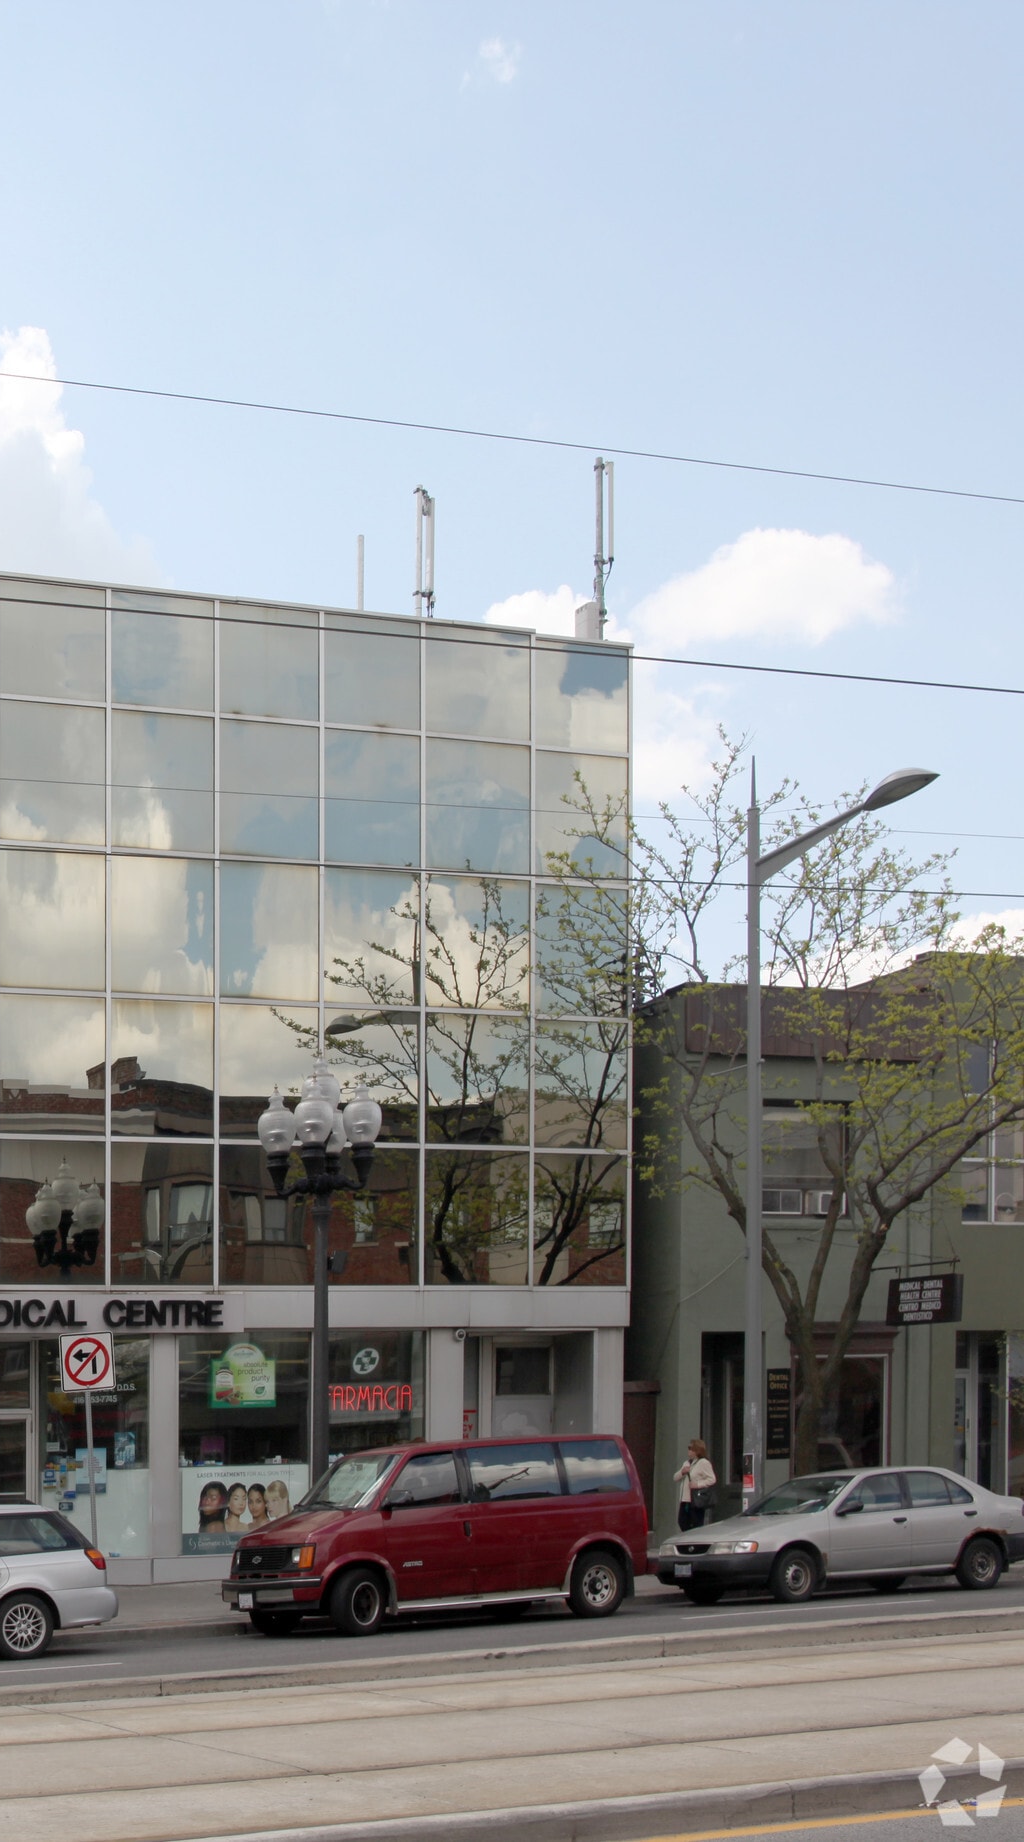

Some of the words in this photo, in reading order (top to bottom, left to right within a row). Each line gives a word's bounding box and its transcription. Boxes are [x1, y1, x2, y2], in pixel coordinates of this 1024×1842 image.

[900, 1290, 920, 1300] HEALTH
[921, 1289, 942, 1299] CENTRE
[103, 1299, 224, 1327] CENTRE
[237, 1368, 263, 1376] product
[251, 1375, 271, 1383] purity
